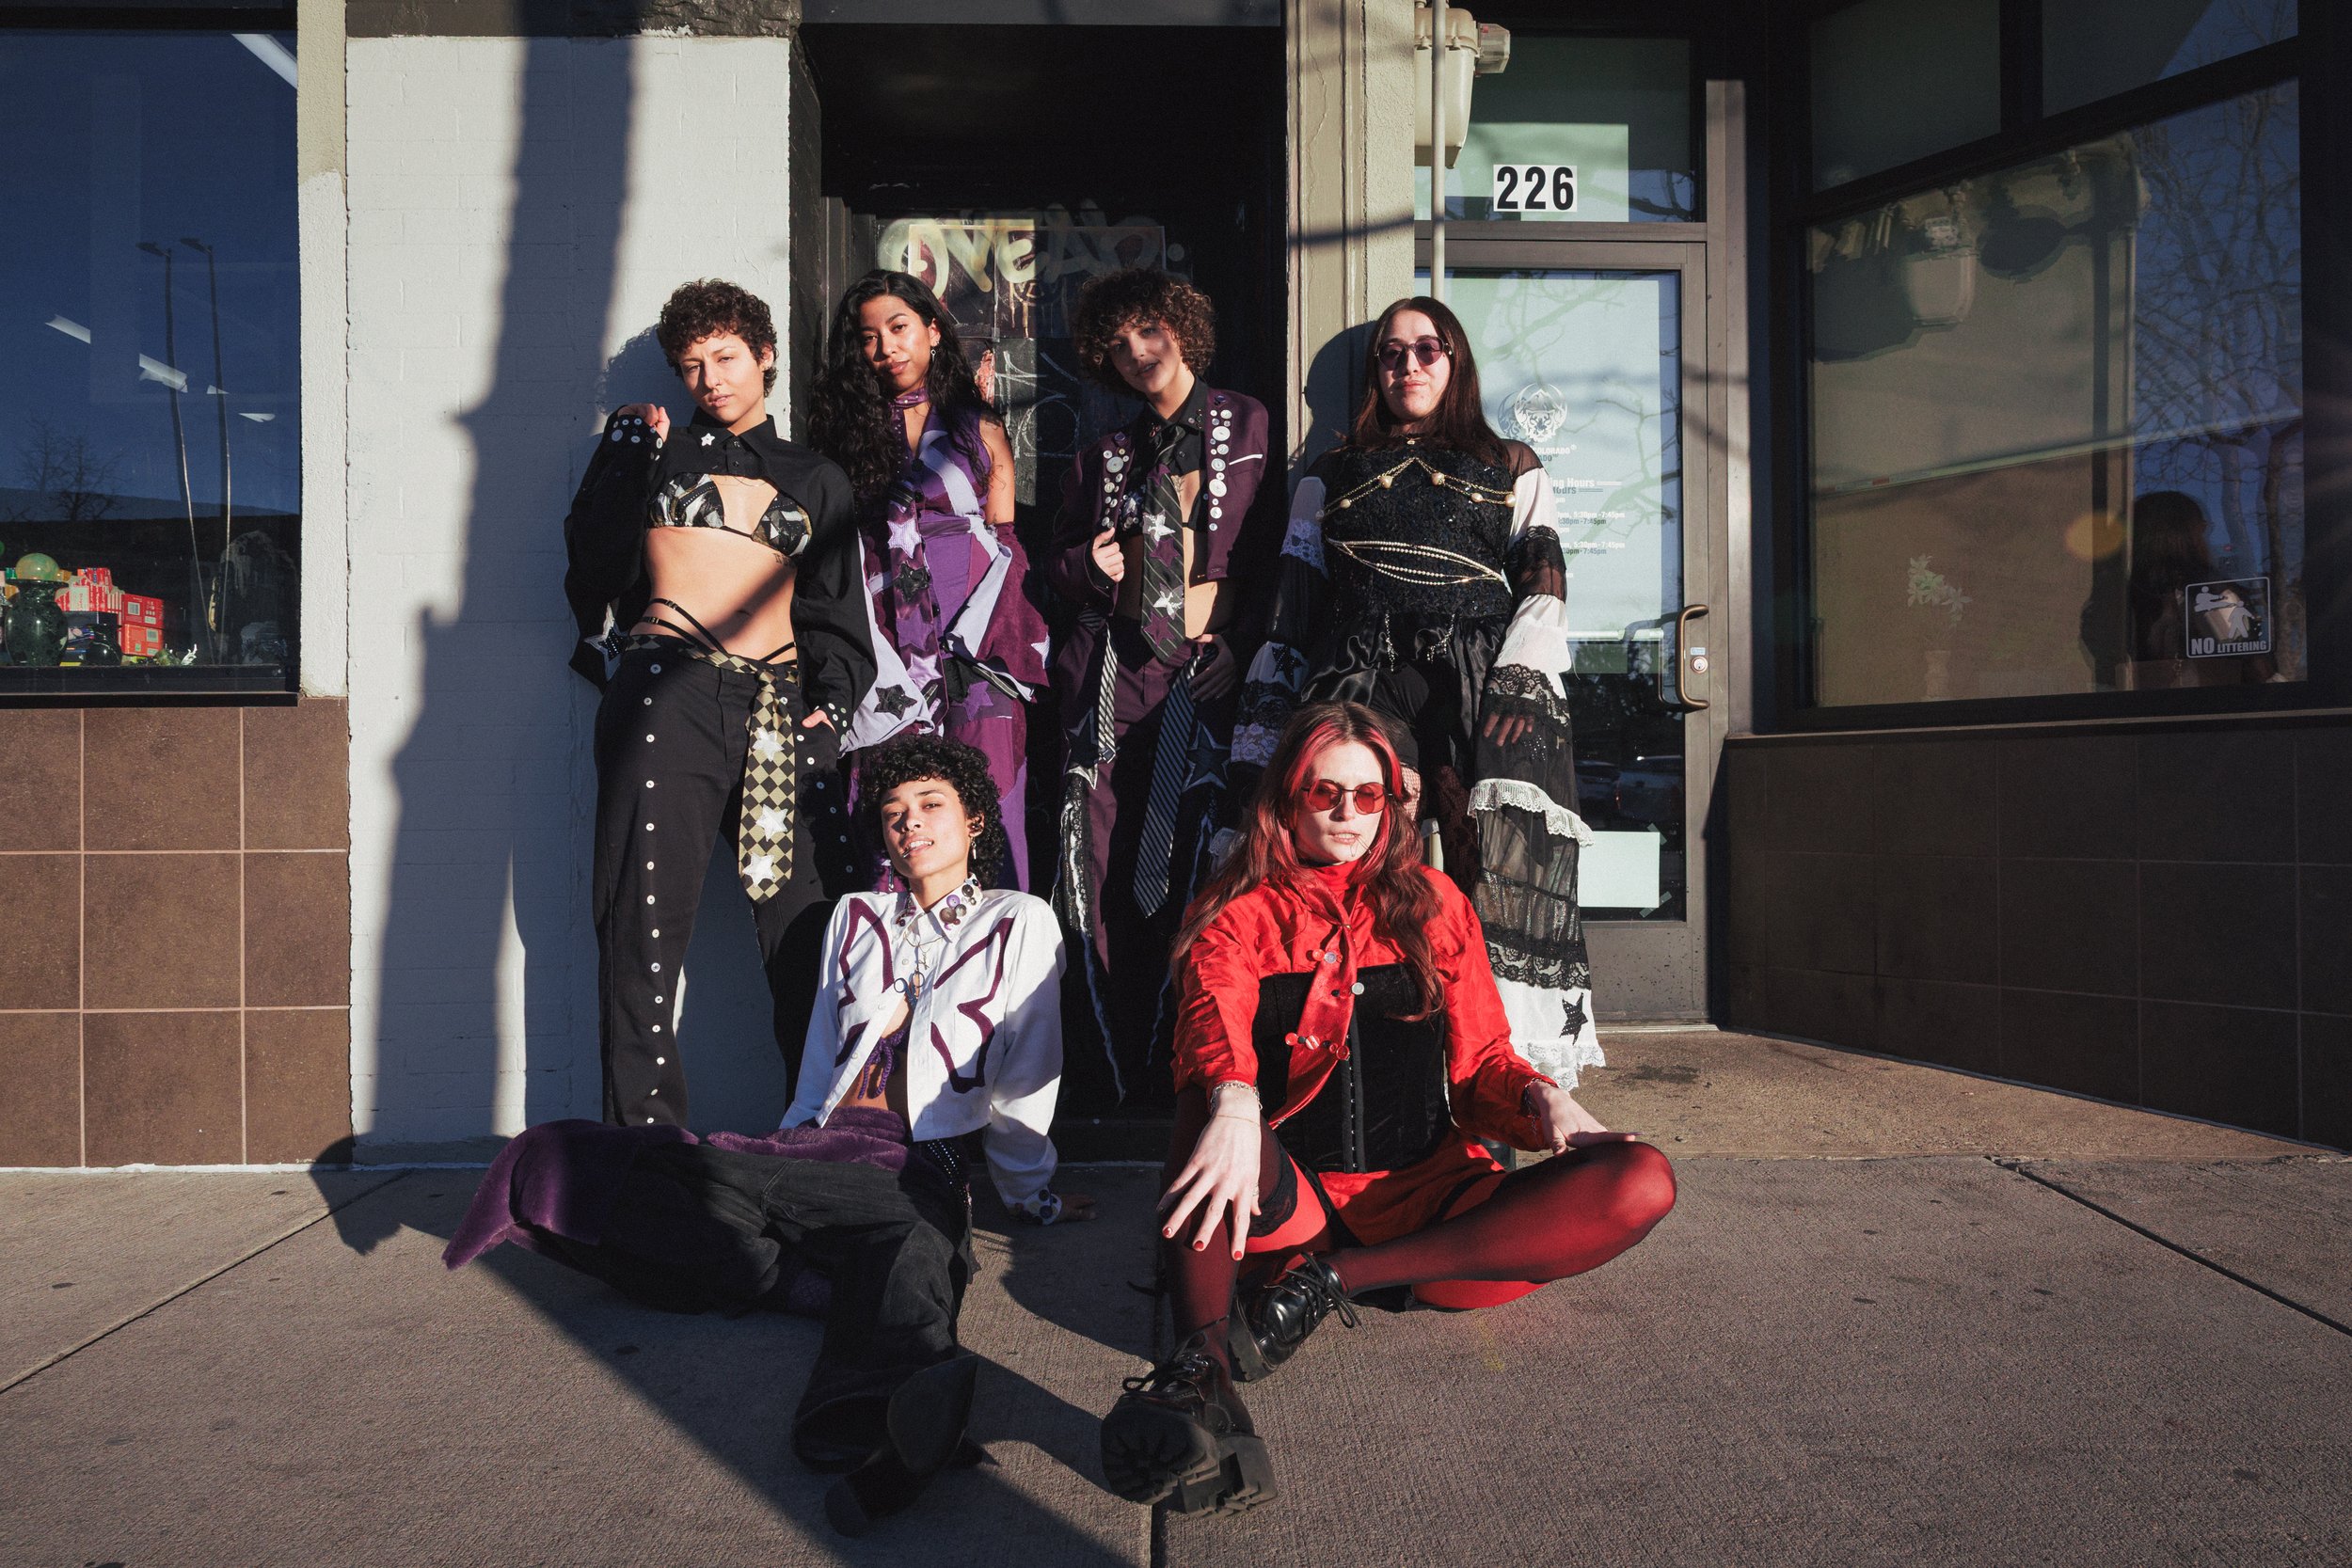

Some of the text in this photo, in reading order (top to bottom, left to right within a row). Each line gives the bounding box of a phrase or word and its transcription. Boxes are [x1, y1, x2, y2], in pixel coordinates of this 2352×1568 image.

[1497, 166, 1574, 211] 226
[1566, 478, 1596, 487] Hours
[2191, 637, 2267, 655] NO LITTERING
